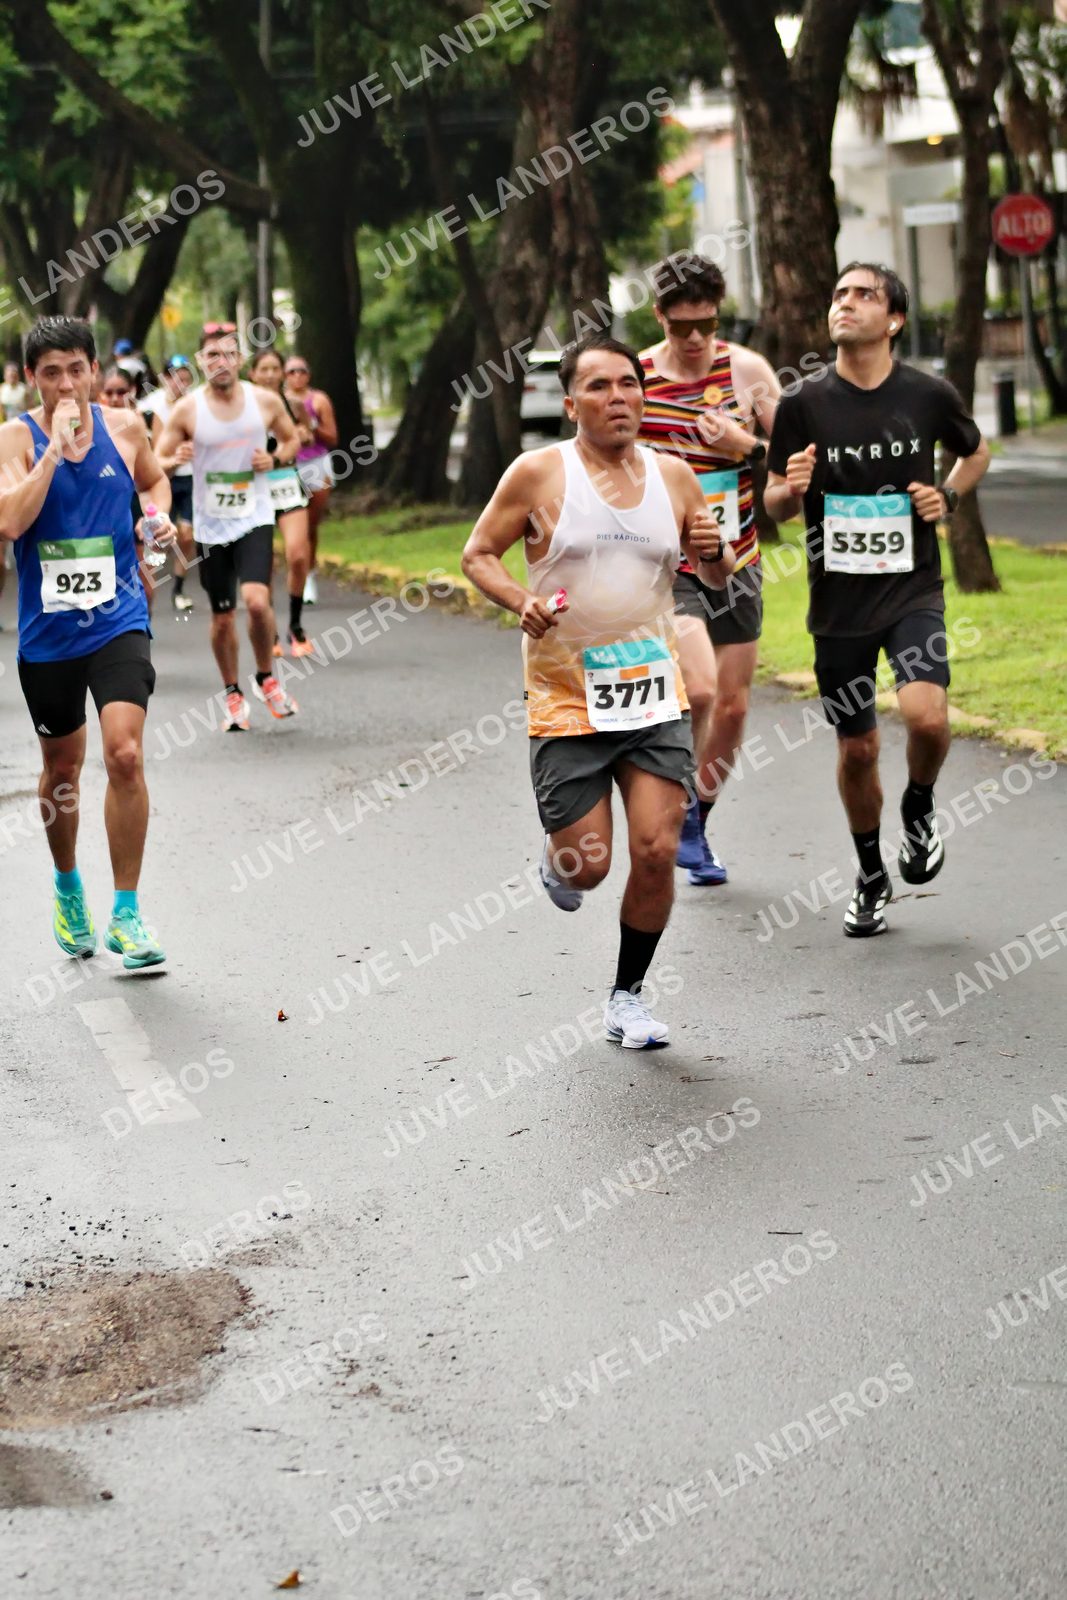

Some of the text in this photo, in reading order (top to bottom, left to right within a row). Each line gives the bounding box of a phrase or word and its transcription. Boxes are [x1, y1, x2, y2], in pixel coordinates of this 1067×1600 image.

[997, 210, 1051, 239] ALTO
[216, 493, 247, 507] 725
[831, 531, 905, 556] 5359
[56, 571, 102, 595] 923
[593, 676, 665, 710] 3771
